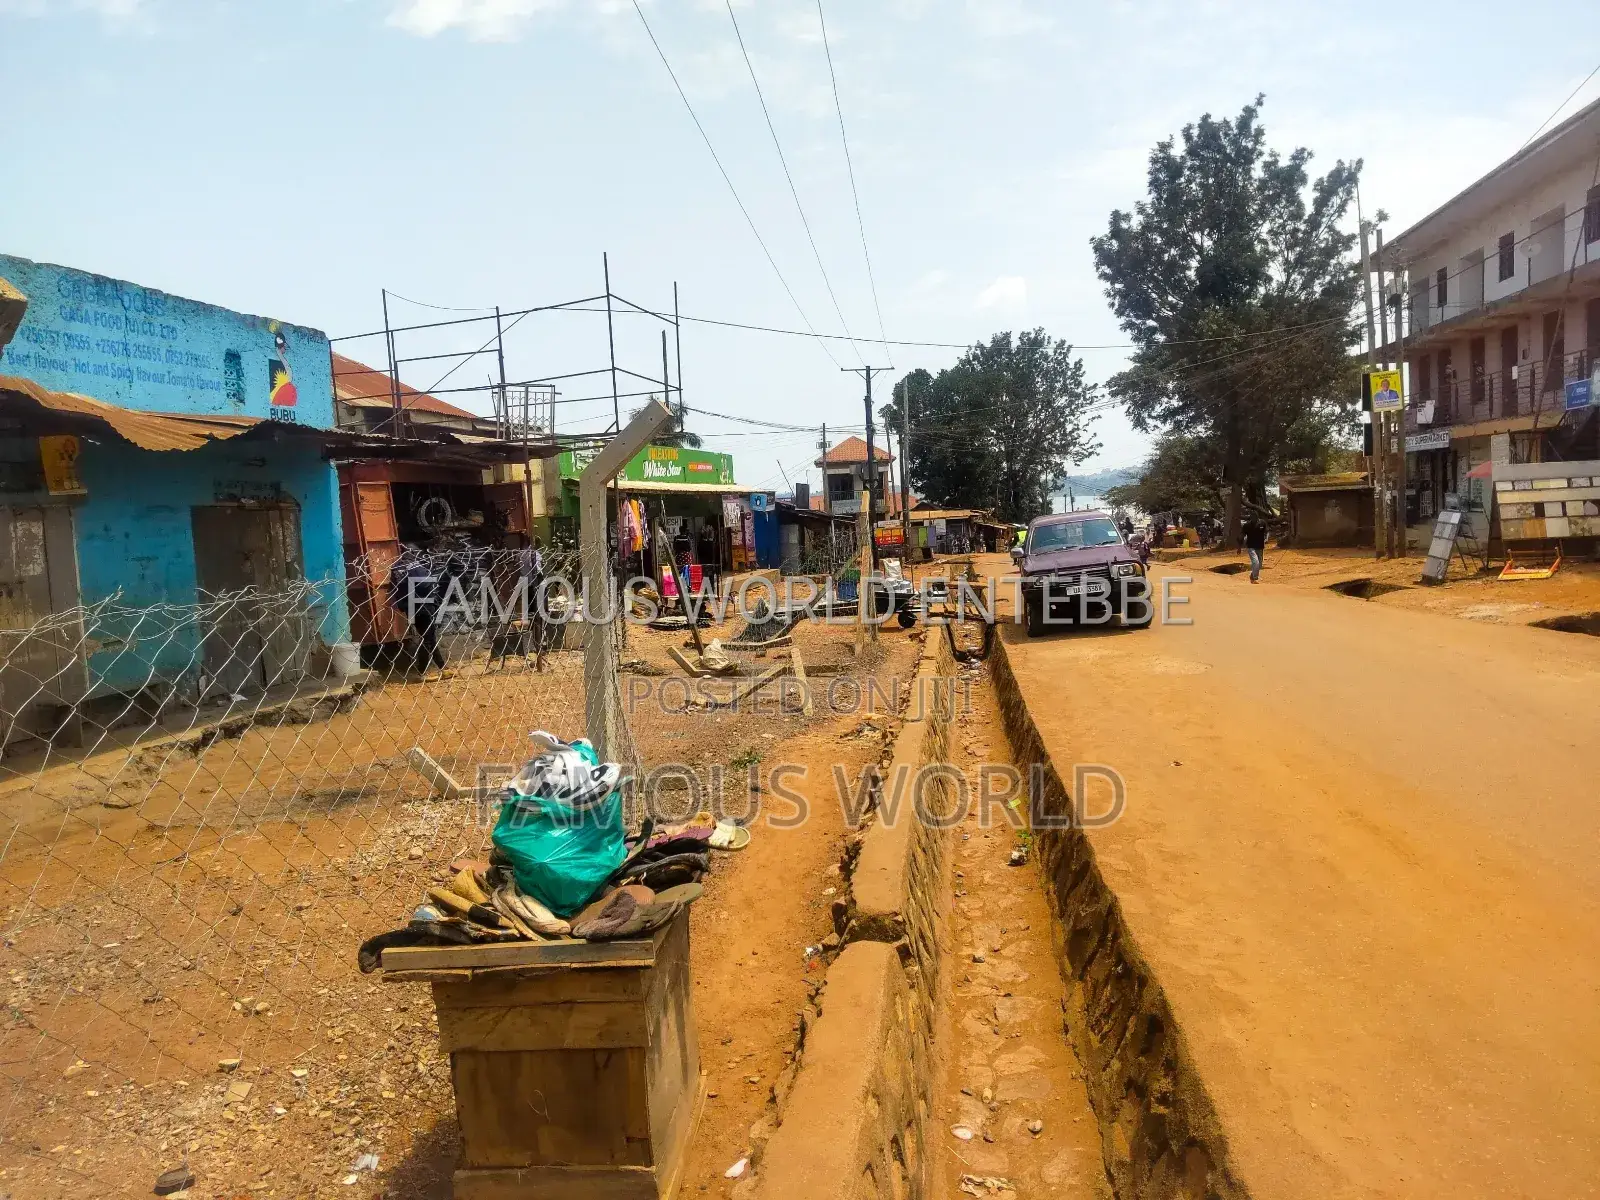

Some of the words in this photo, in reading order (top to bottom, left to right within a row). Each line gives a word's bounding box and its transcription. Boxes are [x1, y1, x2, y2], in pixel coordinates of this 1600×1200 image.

[94, 310, 122, 330] FOOD
[93, 362, 108, 377] and
[270, 408, 296, 421] BUBU
[1415, 432, 1449, 445] SUPERMARKET
[643, 460, 666, 478] White
[667, 461, 682, 477] Star
